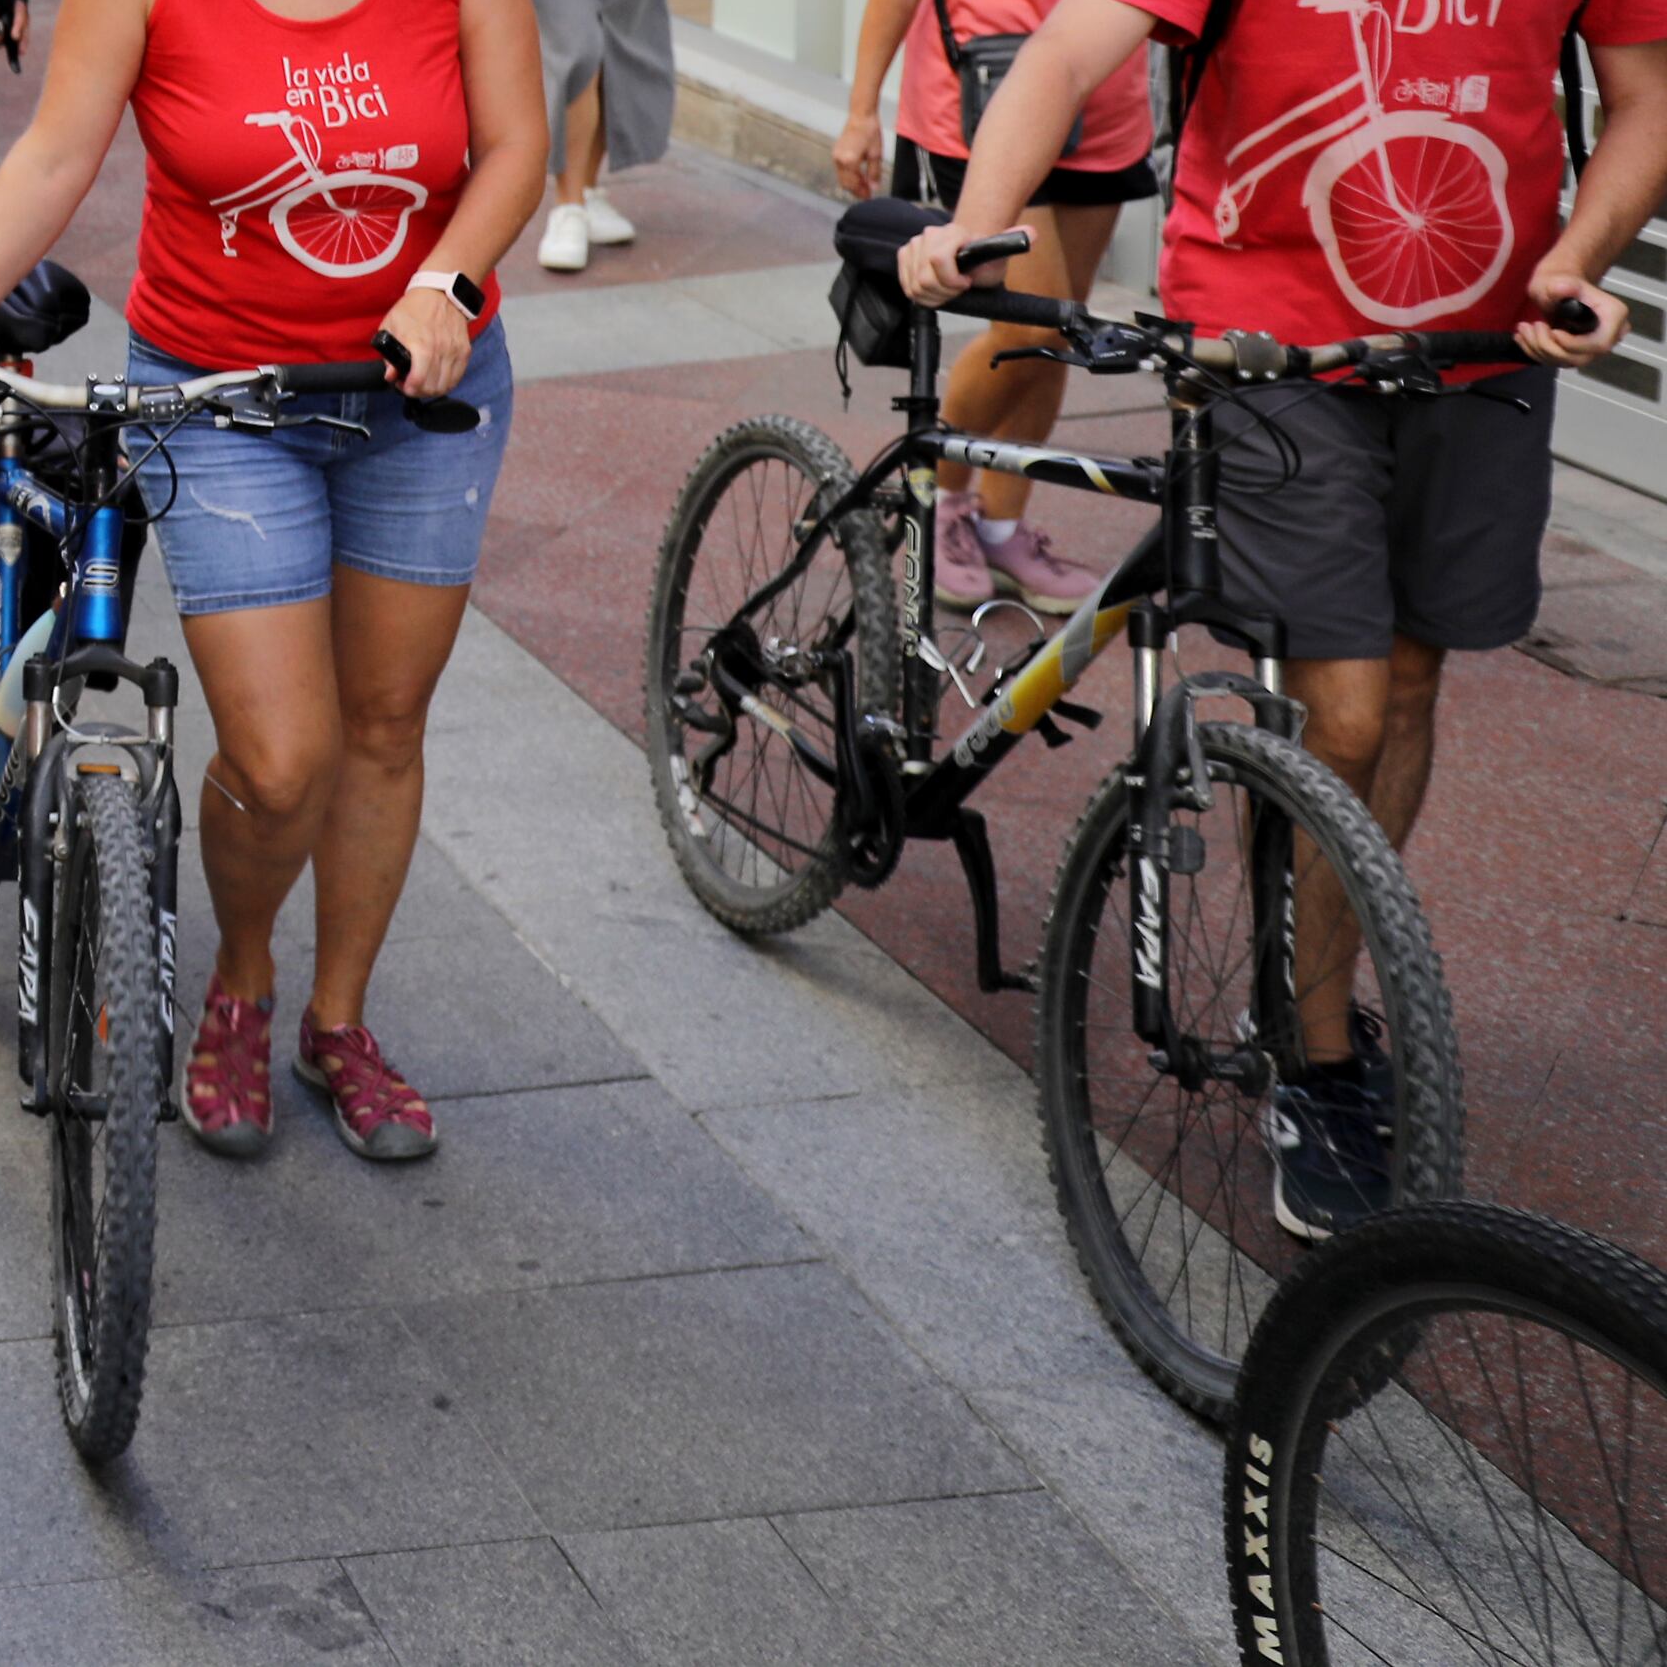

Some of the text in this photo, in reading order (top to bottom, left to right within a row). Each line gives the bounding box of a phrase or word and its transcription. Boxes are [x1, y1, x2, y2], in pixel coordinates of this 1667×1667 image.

[282, 51, 371, 88] la vida
[285, 84, 389, 129] en Bici
[1244, 1433, 1284, 1666] MAXXIS
